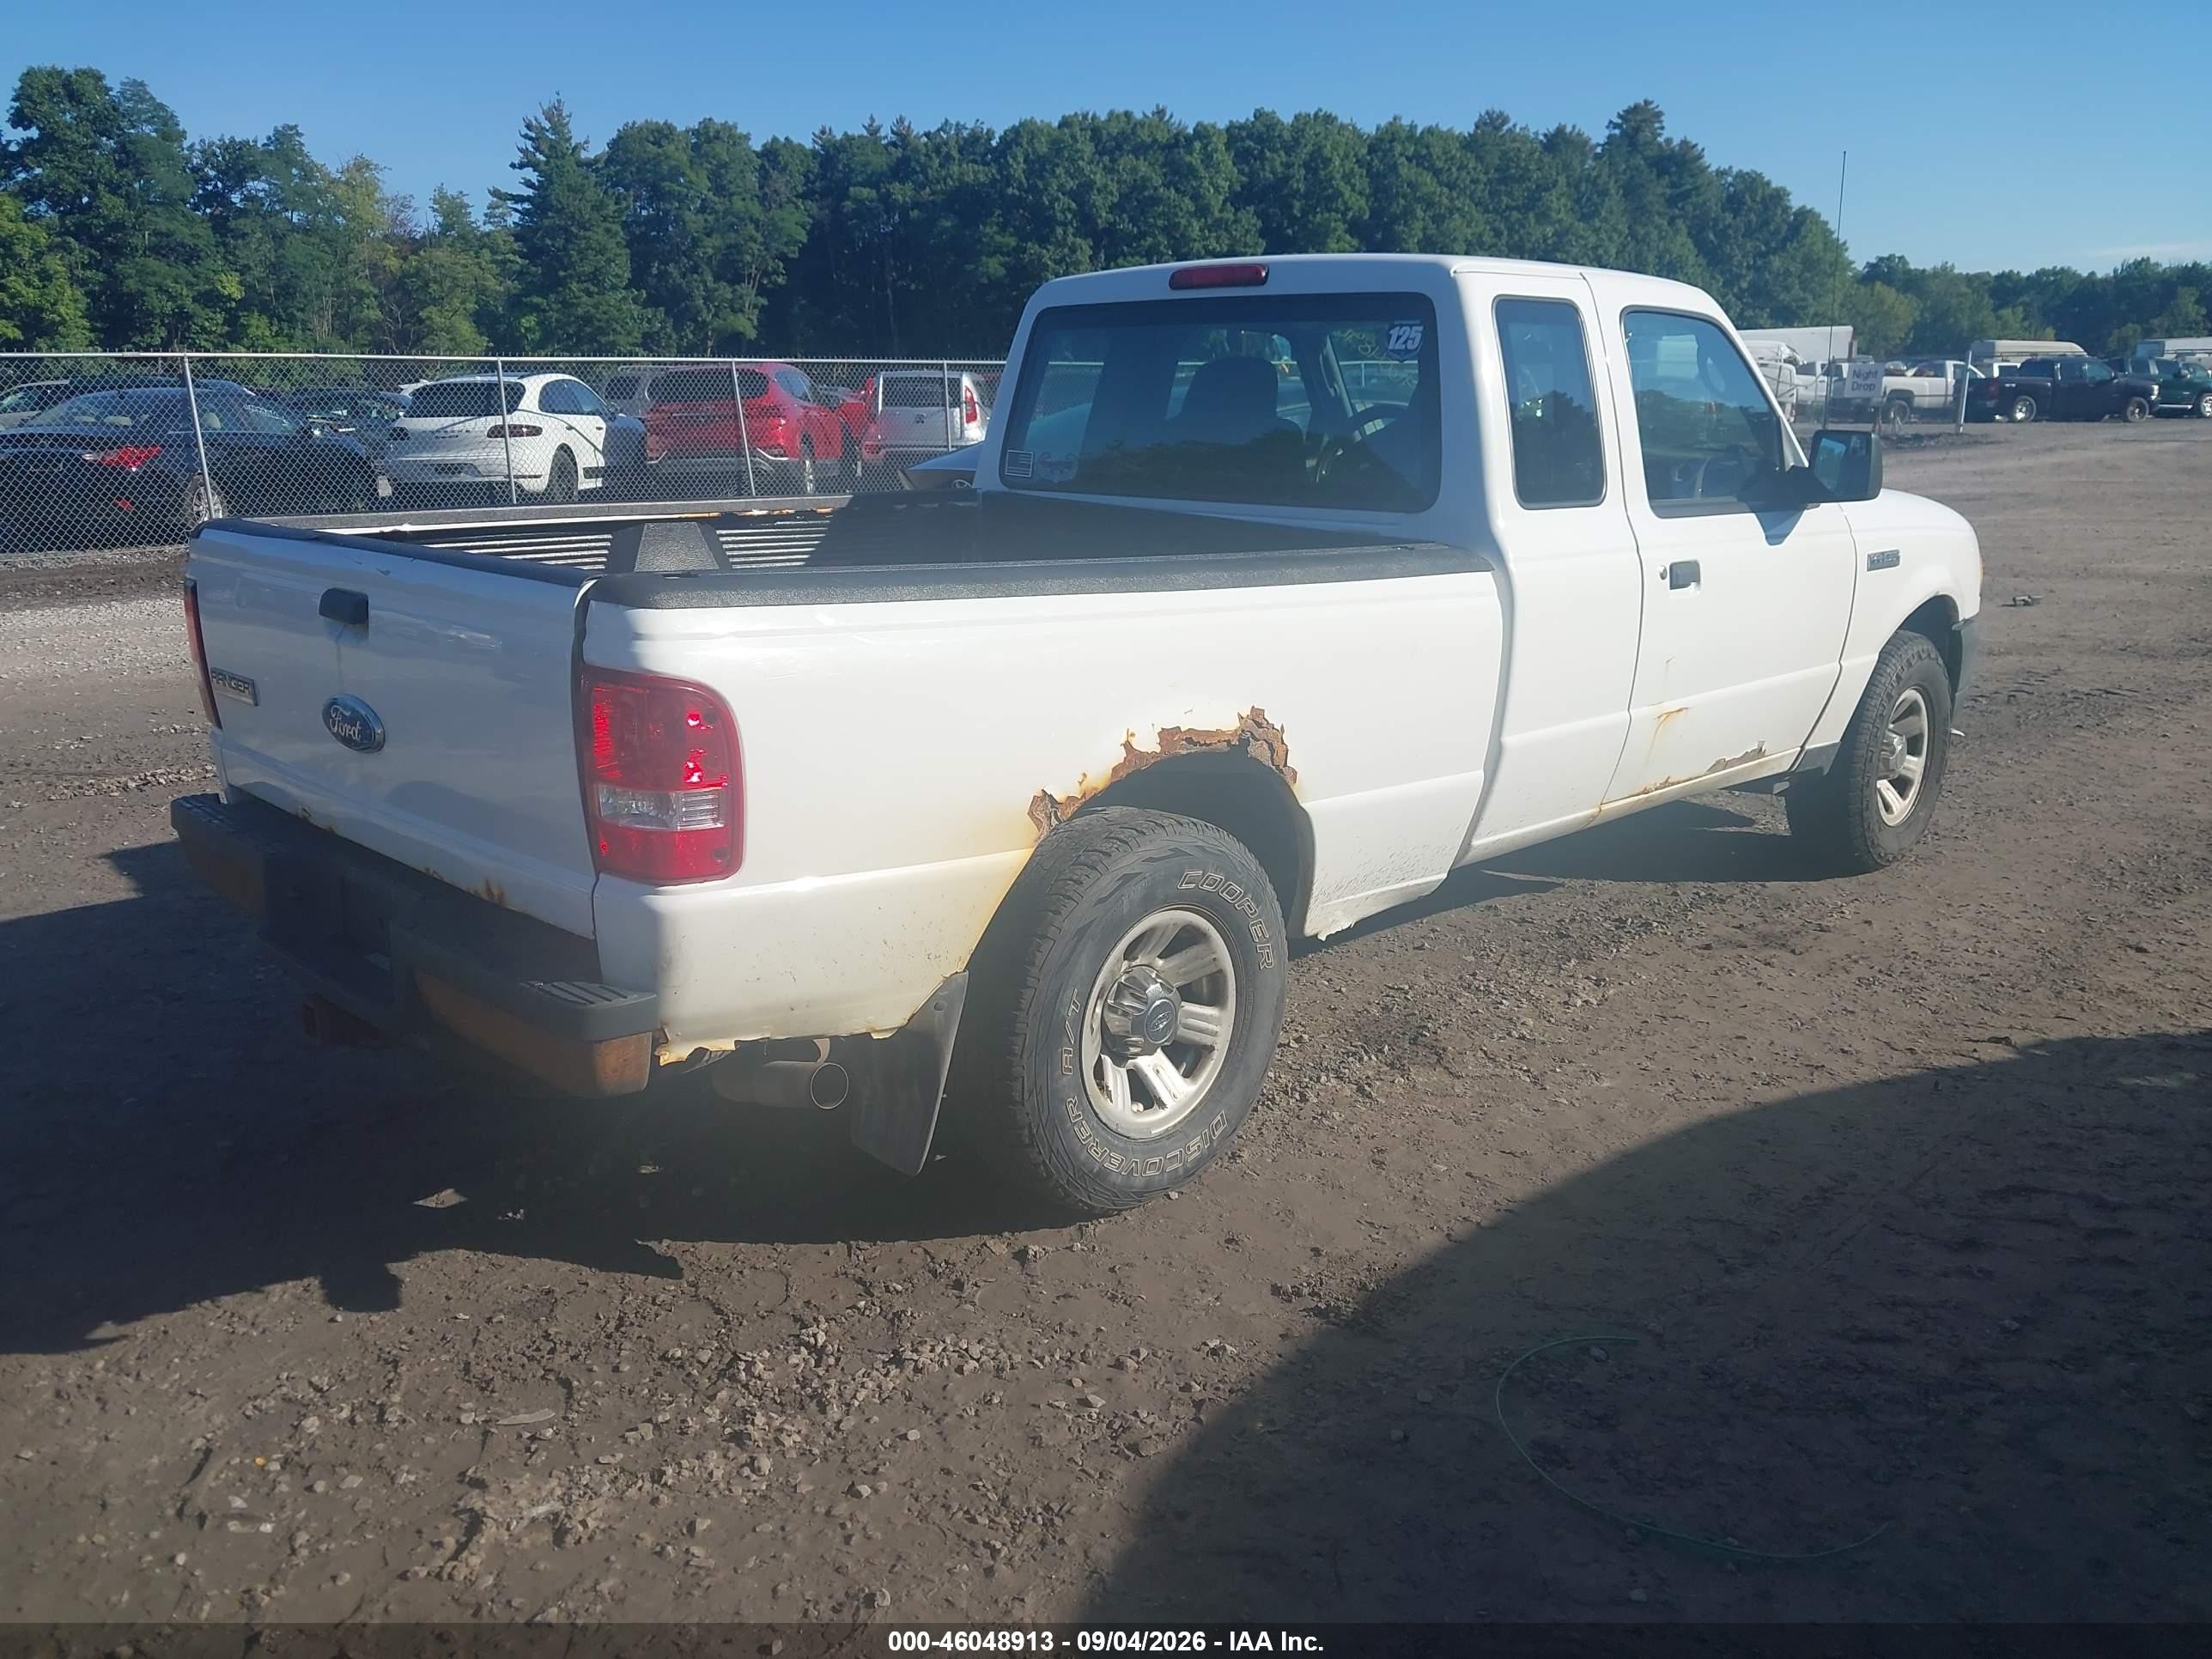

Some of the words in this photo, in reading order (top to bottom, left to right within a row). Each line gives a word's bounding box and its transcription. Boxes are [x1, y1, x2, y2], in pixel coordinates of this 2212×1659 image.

[1388, 325, 1424, 349] 125
[1851, 381, 1875, 392] Drop
[1853, 370, 1878, 381] Night
[330, 705, 362, 741] Ford
[1176, 870, 1275, 970] COOPER
[1060, 988, 1081, 1075] A/T
[1065, 1095, 1228, 1177] DISCOVERER
